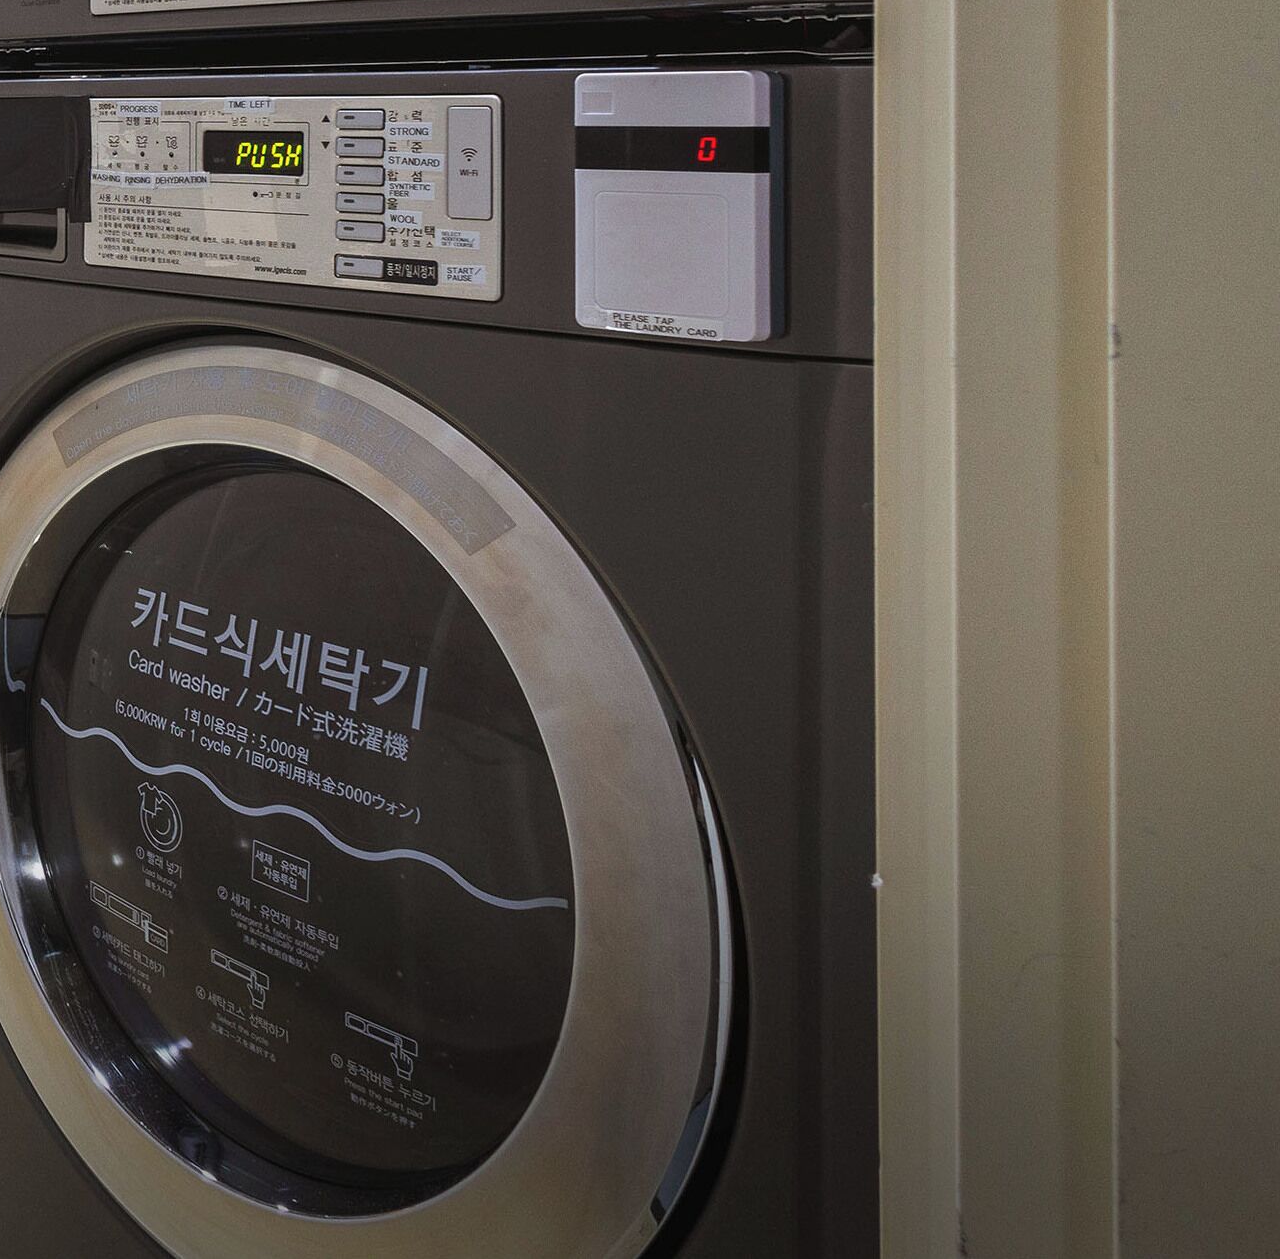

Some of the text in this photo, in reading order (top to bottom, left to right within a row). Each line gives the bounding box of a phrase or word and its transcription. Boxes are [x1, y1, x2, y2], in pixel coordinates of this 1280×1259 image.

[120, 104, 159, 114] PROGRESS
[228, 100, 271, 109] TIME LEFT
[390, 127, 429, 136] STRONG
[236, 141, 303, 169] PUSH
[388, 156, 441, 168] STANDARD
[92, 173, 207, 185] WASHING RINSING DEHYDRATION
[389, 183, 431, 191] SYNTHETIC
[390, 190, 409, 198] FIBER
[390, 214, 418, 224] WOOL
[446, 274, 473, 282] PAUSE
[612, 312, 675, 325] PLEASE TAP
[613, 320, 718, 339] THE LAUNDRY CARD
[130, 587, 429, 731] 카드식세탁기
[128, 648, 164, 679] Card
[168, 665, 230, 703] washer
[114, 698, 168, 731] (5,000KRW
[170, 720, 187, 738] for
[189, 728, 196, 743] 1
[199, 735, 232, 758] cycle
[183, 707, 311, 767] 1회 이용요금 5,000원
[262, 867, 299, 891] 자동투입
[230, 891, 340, 951] 세제 유연제 자동투입
